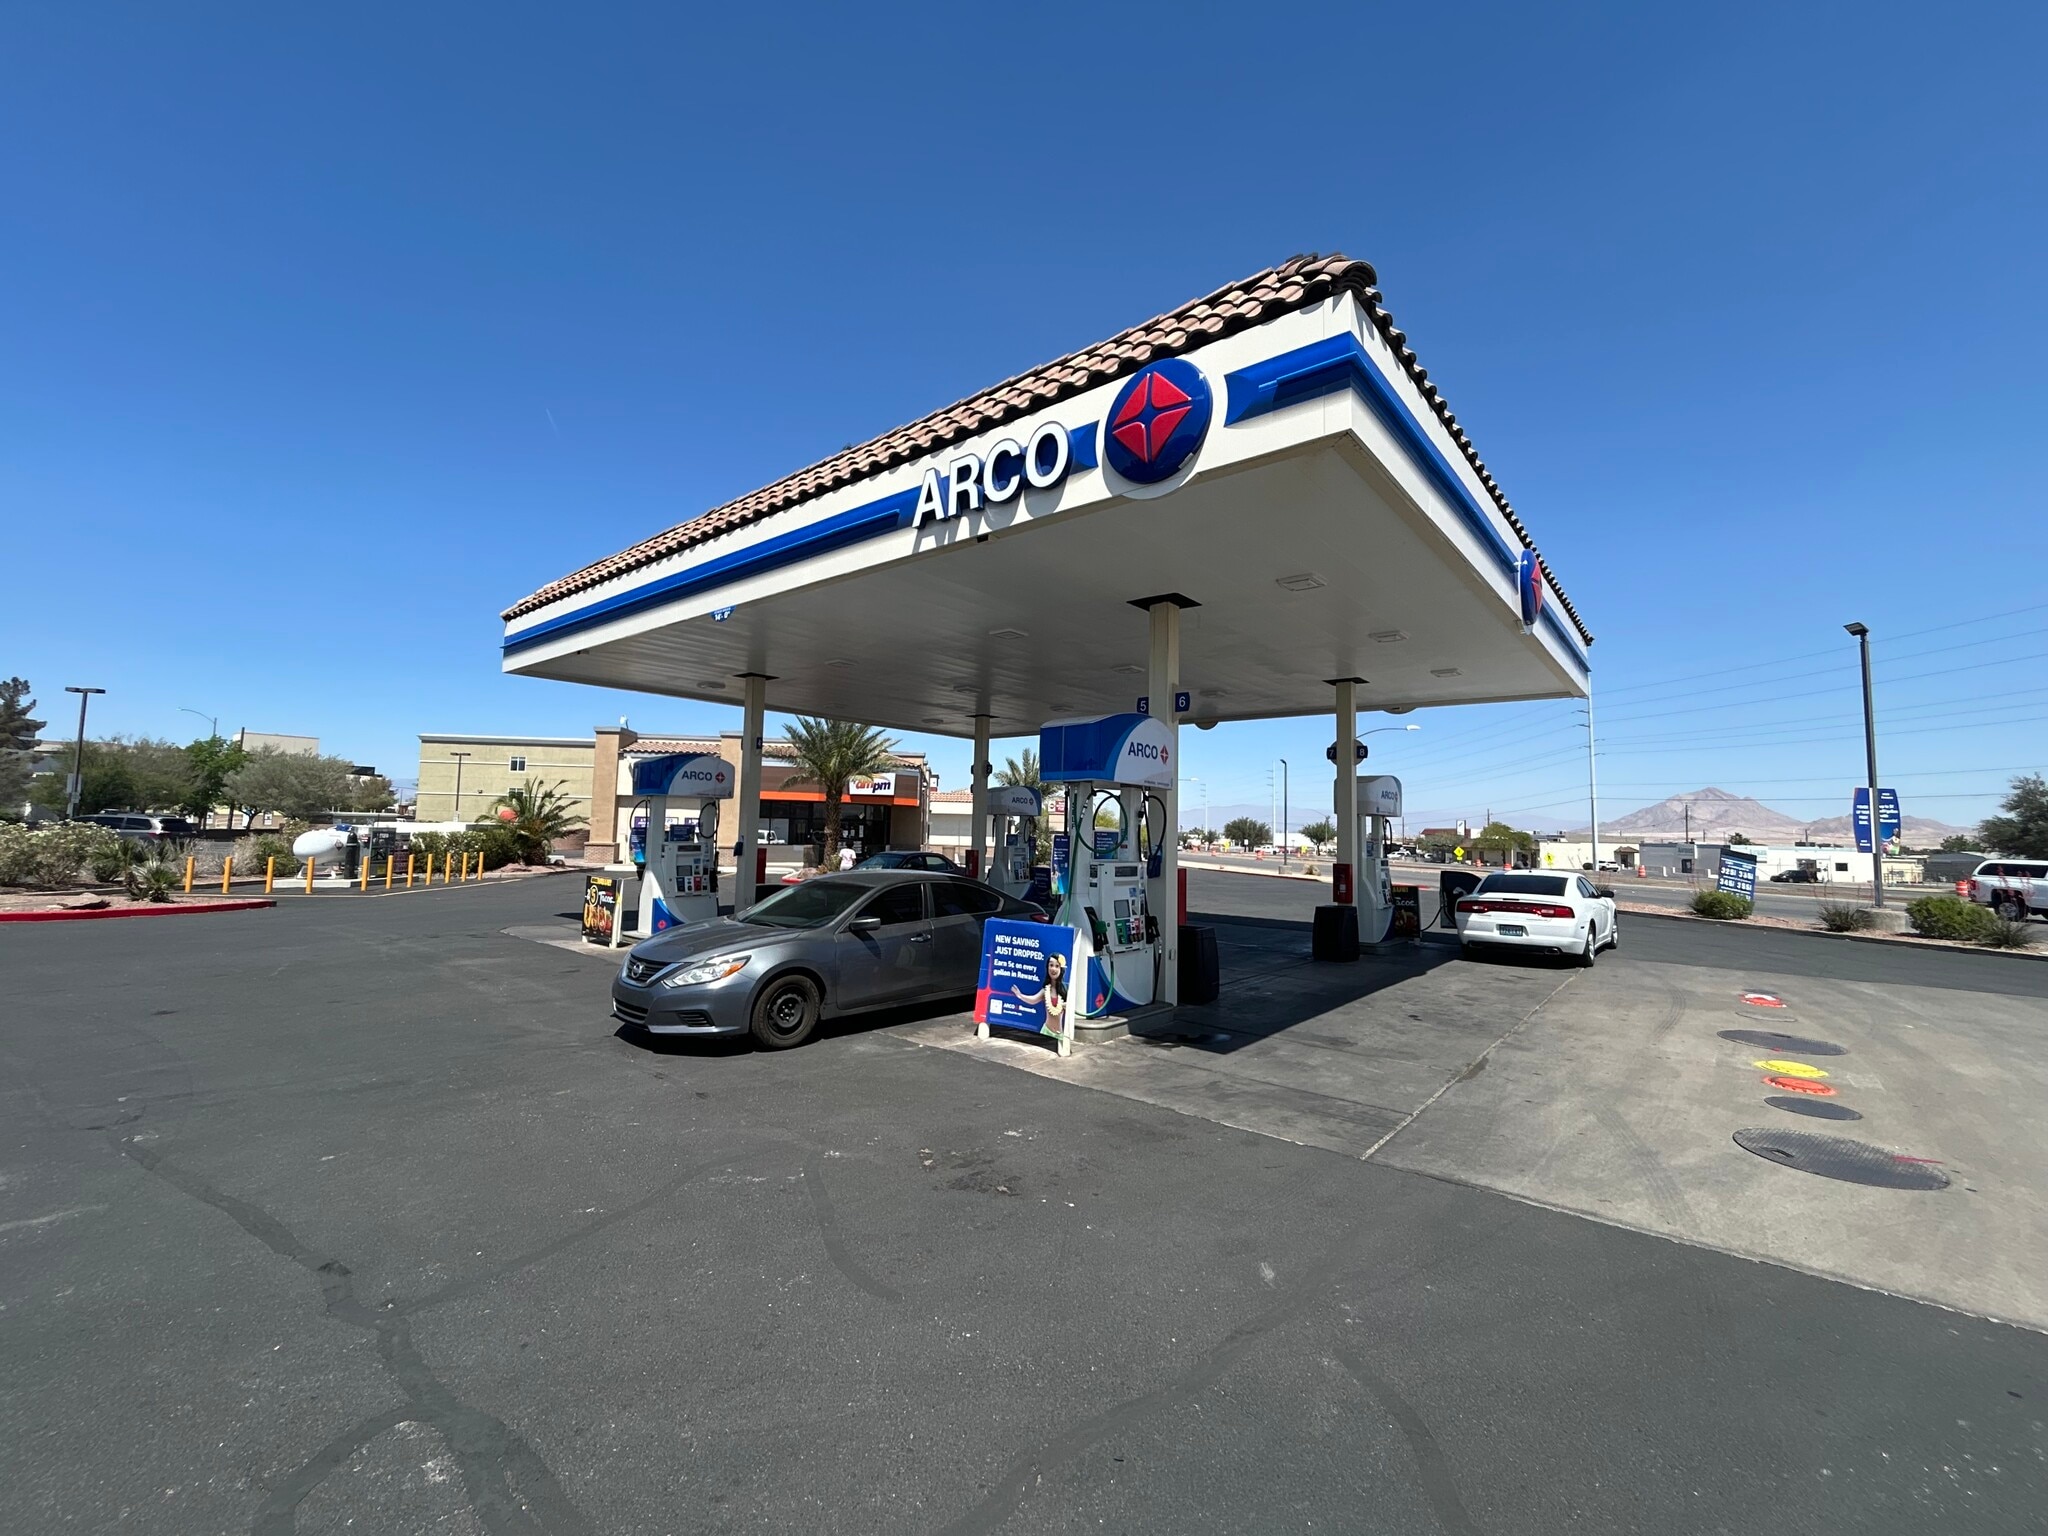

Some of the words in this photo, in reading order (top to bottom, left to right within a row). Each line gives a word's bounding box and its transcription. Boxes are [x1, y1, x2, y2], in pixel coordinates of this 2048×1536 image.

[912, 421, 1072, 528] ARCO
[1140, 700, 1147, 711] 5
[1179, 696, 1186, 708] 6
[1128, 741, 1159, 760] ARCO
[1328, 749, 1335, 758] 7
[1359, 748, 1365, 757] 8
[682, 770, 713, 781] ARCO
[1011, 797, 1028, 805] ARCO
[1381, 790, 1395, 801] ARCO
[995, 934, 1011, 944] NEW
[1012, 936, 1040, 949] SAVINGS
[994, 945, 1013, 956] JUST
[1013, 948, 1044, 961] DROPPED:
[994, 958, 1008, 967] Earn
[1023, 964, 1038, 973] every
[993, 968, 1011, 977] gallon
[1011, 970, 1017, 978] in
[1017, 971, 1041, 982] Rewards.
[1003, 1002, 1016, 1010] ARCO
